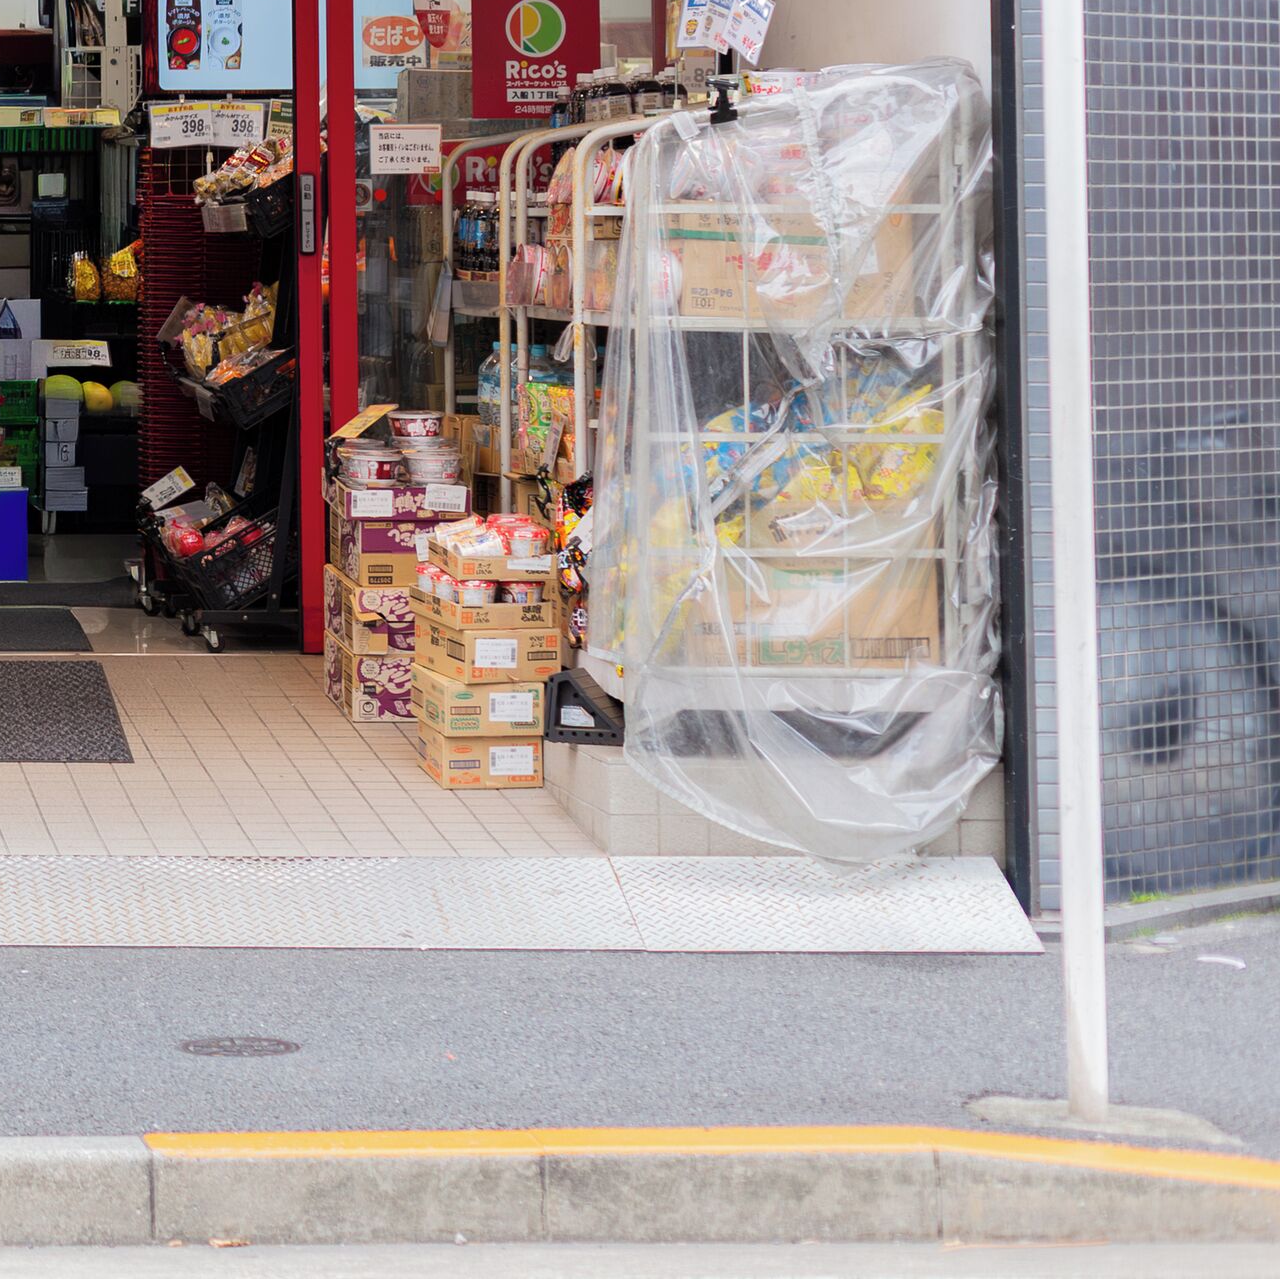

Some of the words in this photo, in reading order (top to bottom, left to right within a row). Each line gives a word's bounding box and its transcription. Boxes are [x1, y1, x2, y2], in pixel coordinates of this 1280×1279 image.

[370, 25, 420, 47] たばこ
[369, 55, 422, 67] 販売中
[505, 60, 568, 79] Rico's
